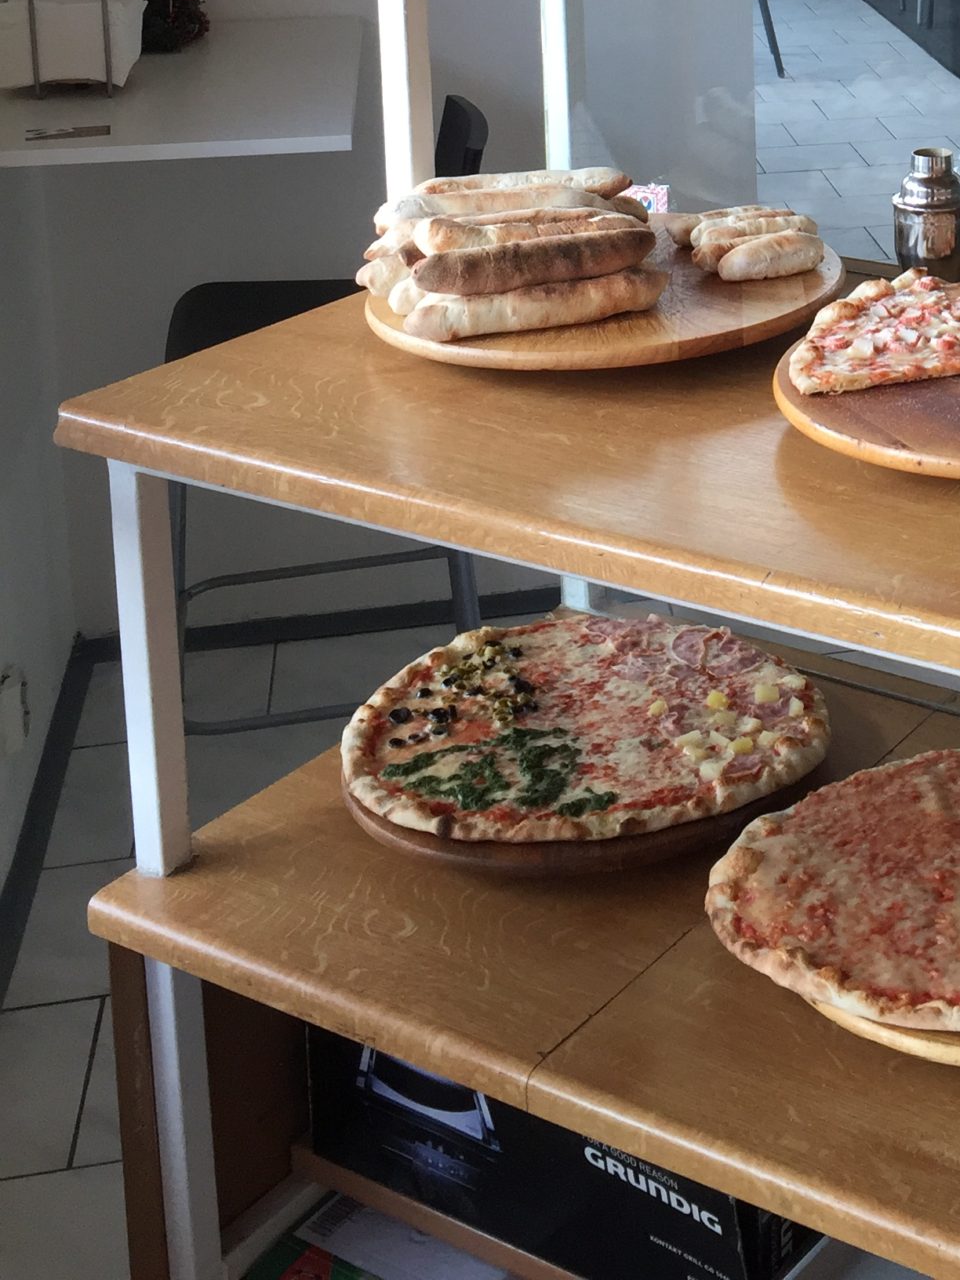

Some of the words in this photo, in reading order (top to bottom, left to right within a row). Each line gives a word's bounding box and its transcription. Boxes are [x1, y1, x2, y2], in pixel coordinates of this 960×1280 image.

[610, 1145, 637, 1167] GOOD
[639, 1161, 679, 1190] REASON
[584, 1146, 722, 1235] GRUNDIG
[650, 1235, 682, 1256] KONTAKT
